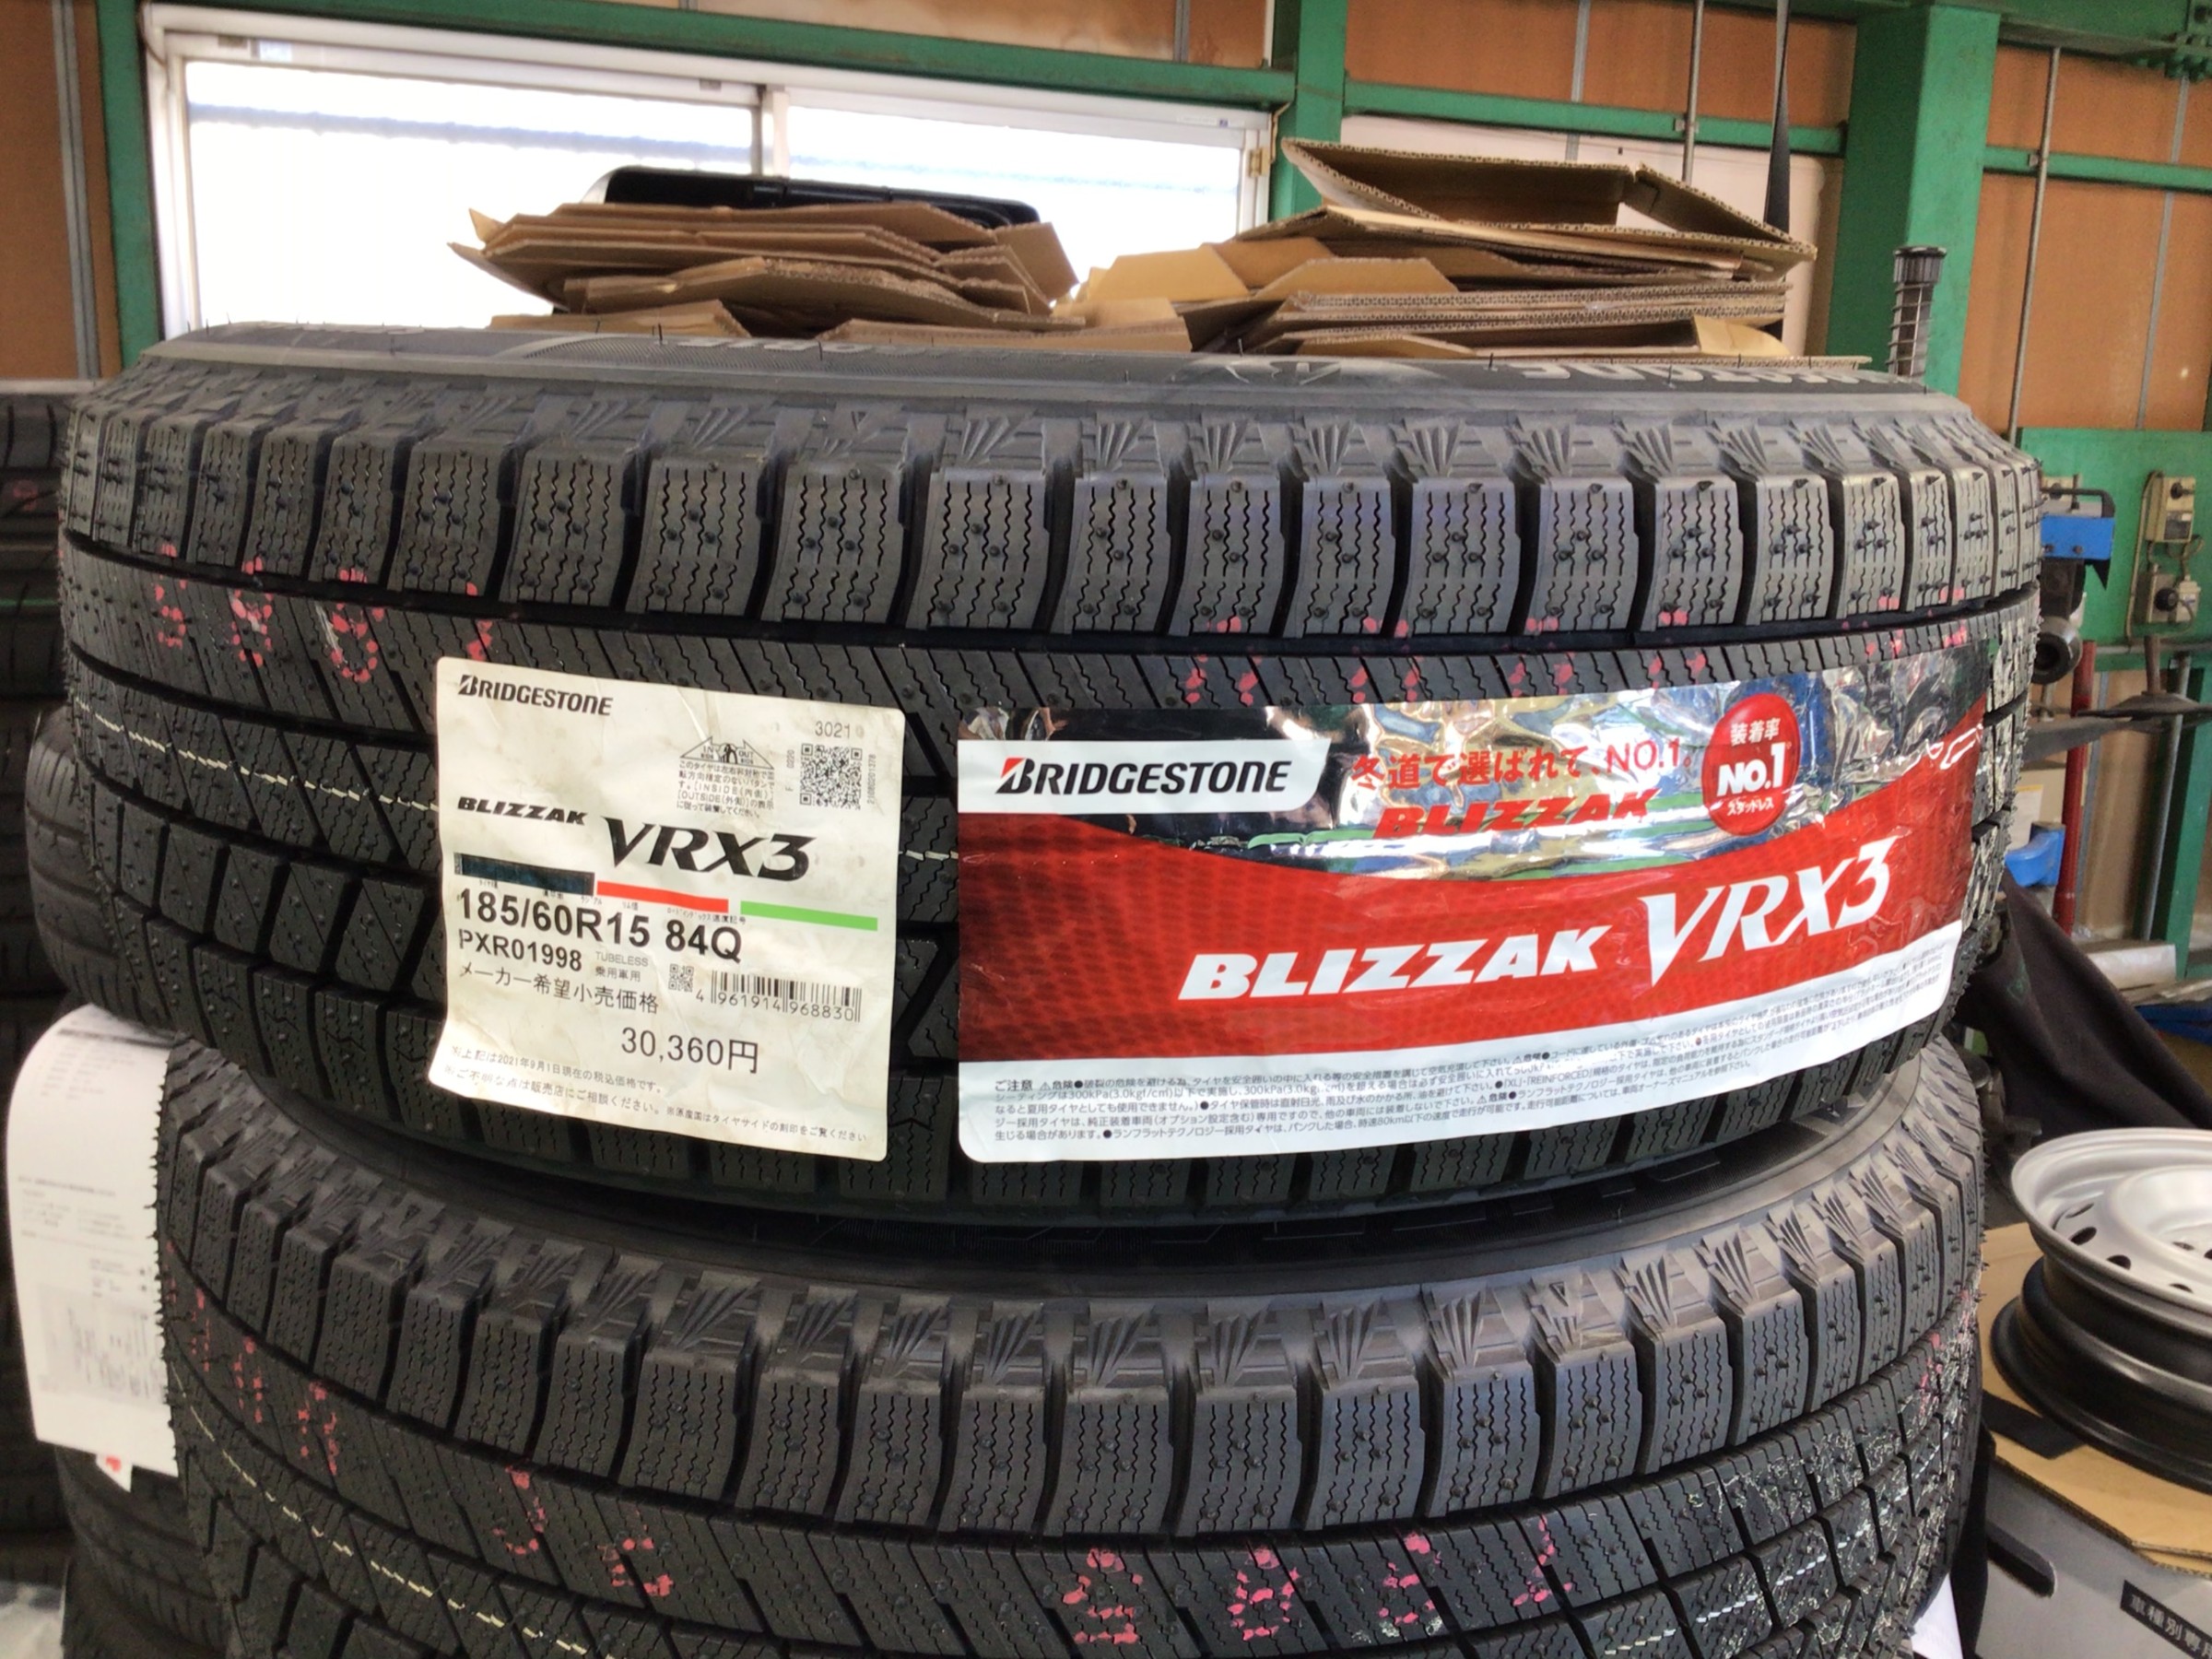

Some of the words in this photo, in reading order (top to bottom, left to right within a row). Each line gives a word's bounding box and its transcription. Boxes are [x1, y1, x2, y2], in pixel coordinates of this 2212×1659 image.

[458, 674, 614, 716] BRIDGESTONE
[815, 721, 851, 738] 3021
[1730, 716, 1781, 744] 装着率
[738, 750, 754, 759] OUT
[995, 758, 1292, 794] BRIDGESTONE
[1717, 742, 1786, 796] NO.1
[1373, 788, 1664, 840] BLIZZAK
[457, 795, 588, 826] BLIZZAK
[601, 817, 817, 882] VRX3
[458, 888, 651, 947] 185/60R15
[665, 919, 743, 963] 84Q
[1178, 925, 1612, 1000] BLIZZAK
[1637, 836, 1899, 987] VRX3
[458, 928, 582, 971] PXR01998
[595, 950, 650, 967] TUBELESS
[458, 960, 660, 1015] メーカー希望小売価格
[696, 990, 705, 1005] 4
[717, 991, 782, 1013] 961914
[789, 999, 854, 1022] 968830
[620, 1027, 759, 1075] 30,360円
[994, 1079, 1033, 1092] ご注意
